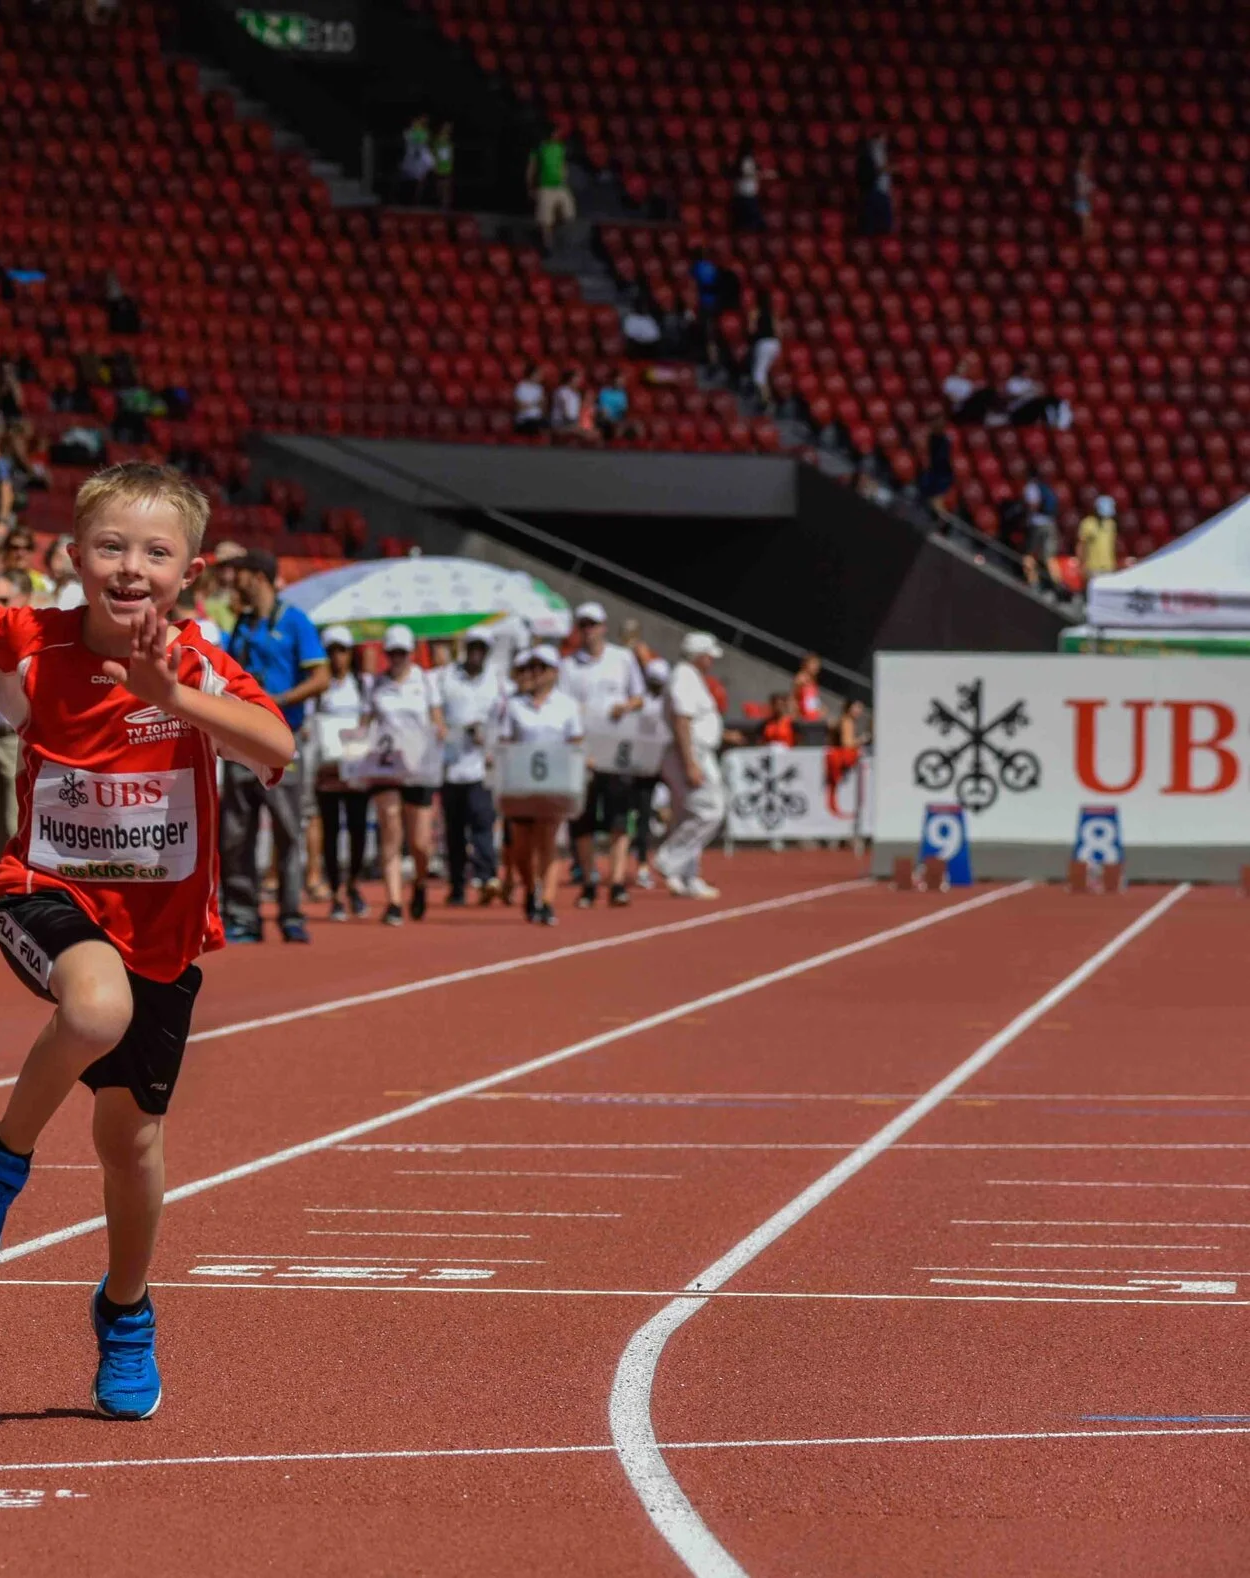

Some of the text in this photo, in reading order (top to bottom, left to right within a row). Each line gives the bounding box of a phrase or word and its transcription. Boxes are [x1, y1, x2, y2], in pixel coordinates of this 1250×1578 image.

[90, 675, 118, 685] CRA
[126, 728, 143, 738] TV
[1063, 698, 1250, 795] UB
[530, 750, 548, 782] 6
[94, 779, 163, 808] UBS
[39, 815, 189, 851] Huggenberger
[926, 816, 963, 860] 9
[1076, 816, 1121, 870] 8
[87, 863, 136, 877] KIDS
[19, 940, 42, 974] FILA
